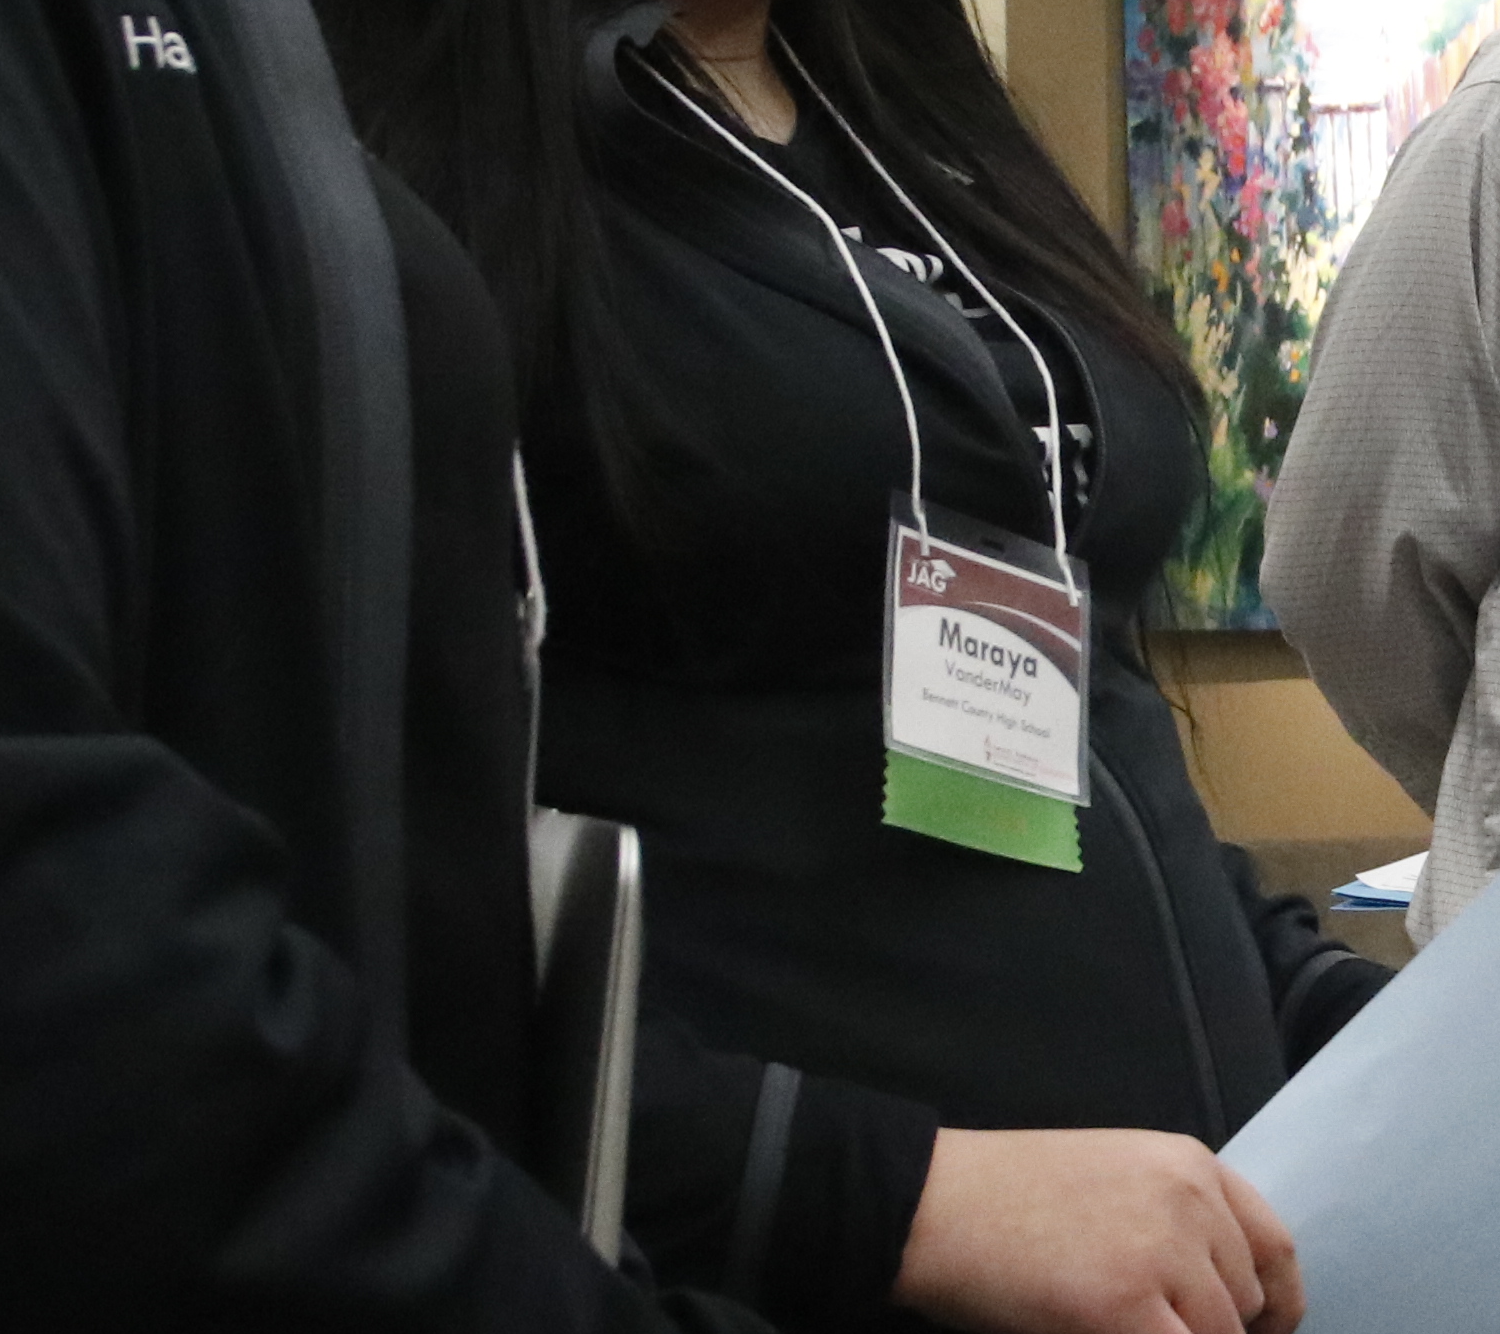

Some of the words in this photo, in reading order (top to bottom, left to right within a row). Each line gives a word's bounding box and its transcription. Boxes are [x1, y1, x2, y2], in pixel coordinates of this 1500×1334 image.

[122, 15, 197, 74] Ha
[908, 561, 948, 594] JAG
[939, 618, 1037, 679] Maraya
[945, 660, 1032, 707] VanderMay
